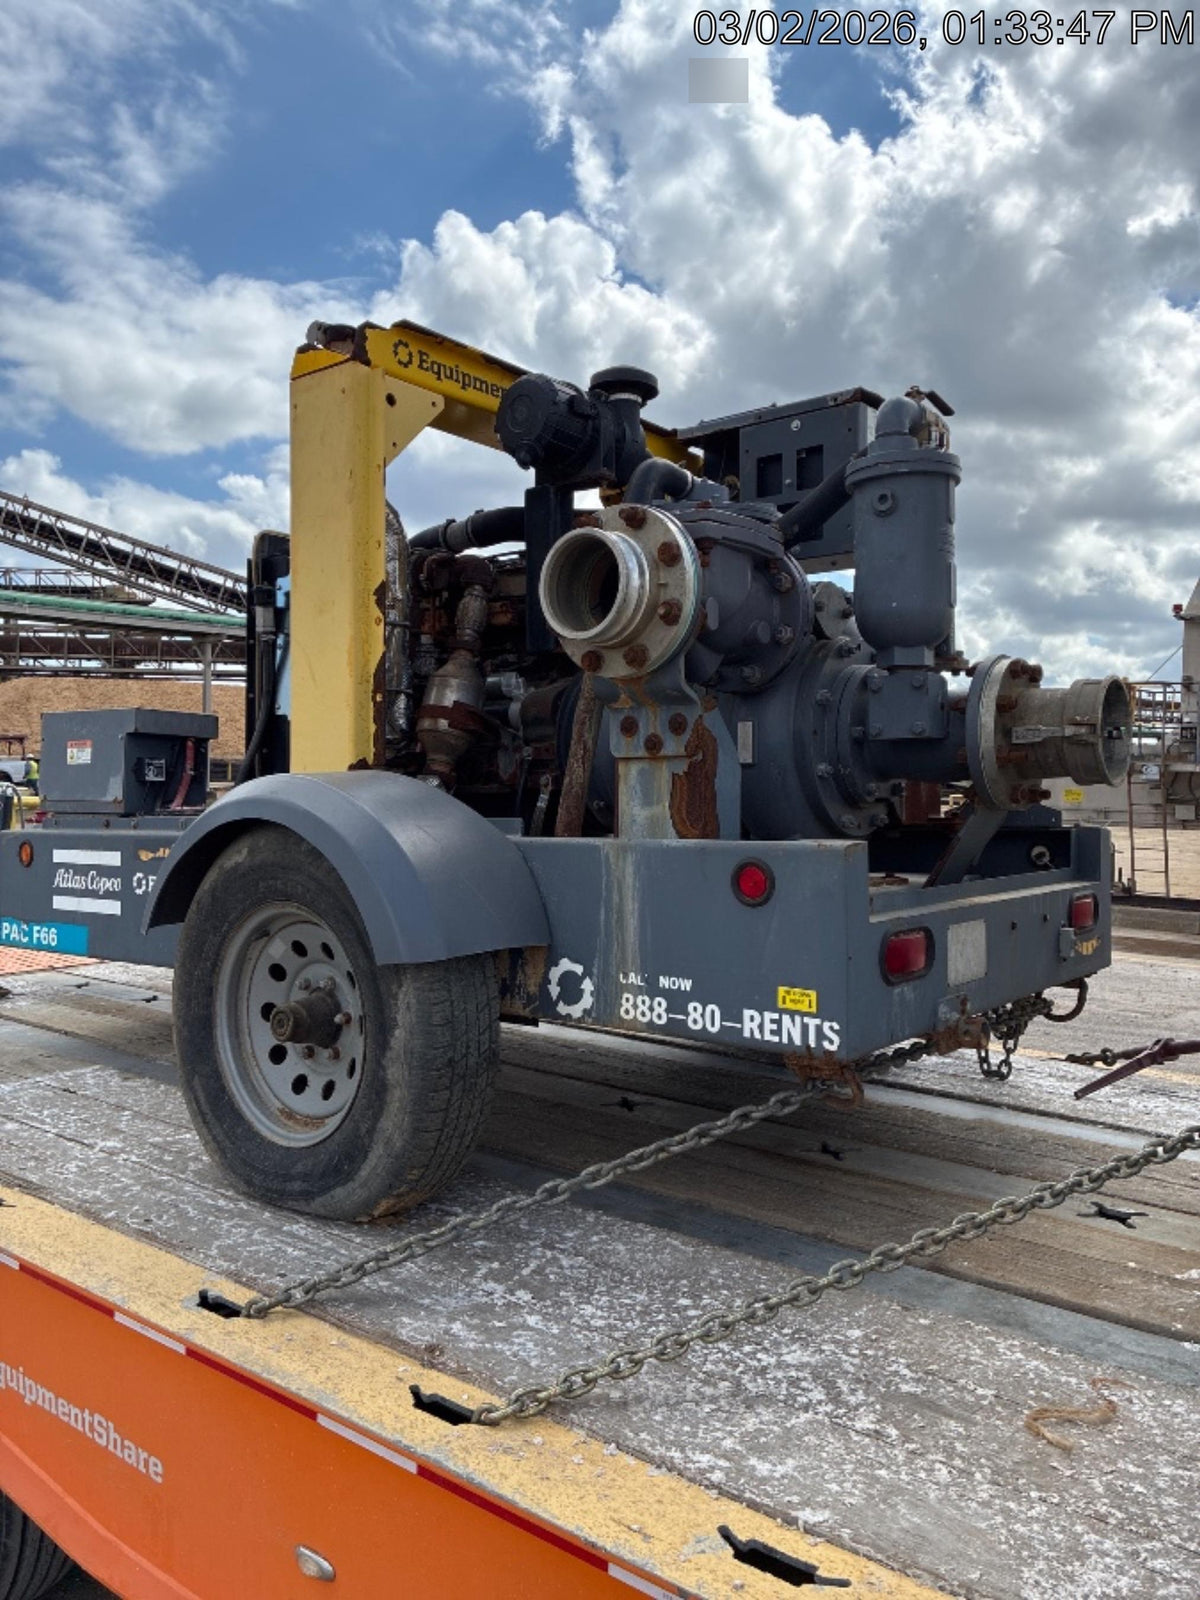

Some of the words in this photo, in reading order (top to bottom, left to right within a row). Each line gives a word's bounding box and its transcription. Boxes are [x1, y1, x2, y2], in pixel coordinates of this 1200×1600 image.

[53, 868, 87, 890] Atlas
[88, 870, 122, 895] Copco
[1, 921, 29, 943] PAC
[32, 926, 58, 947] F66
[619, 972, 648, 986] CAL
[659, 976, 693, 991] NOW
